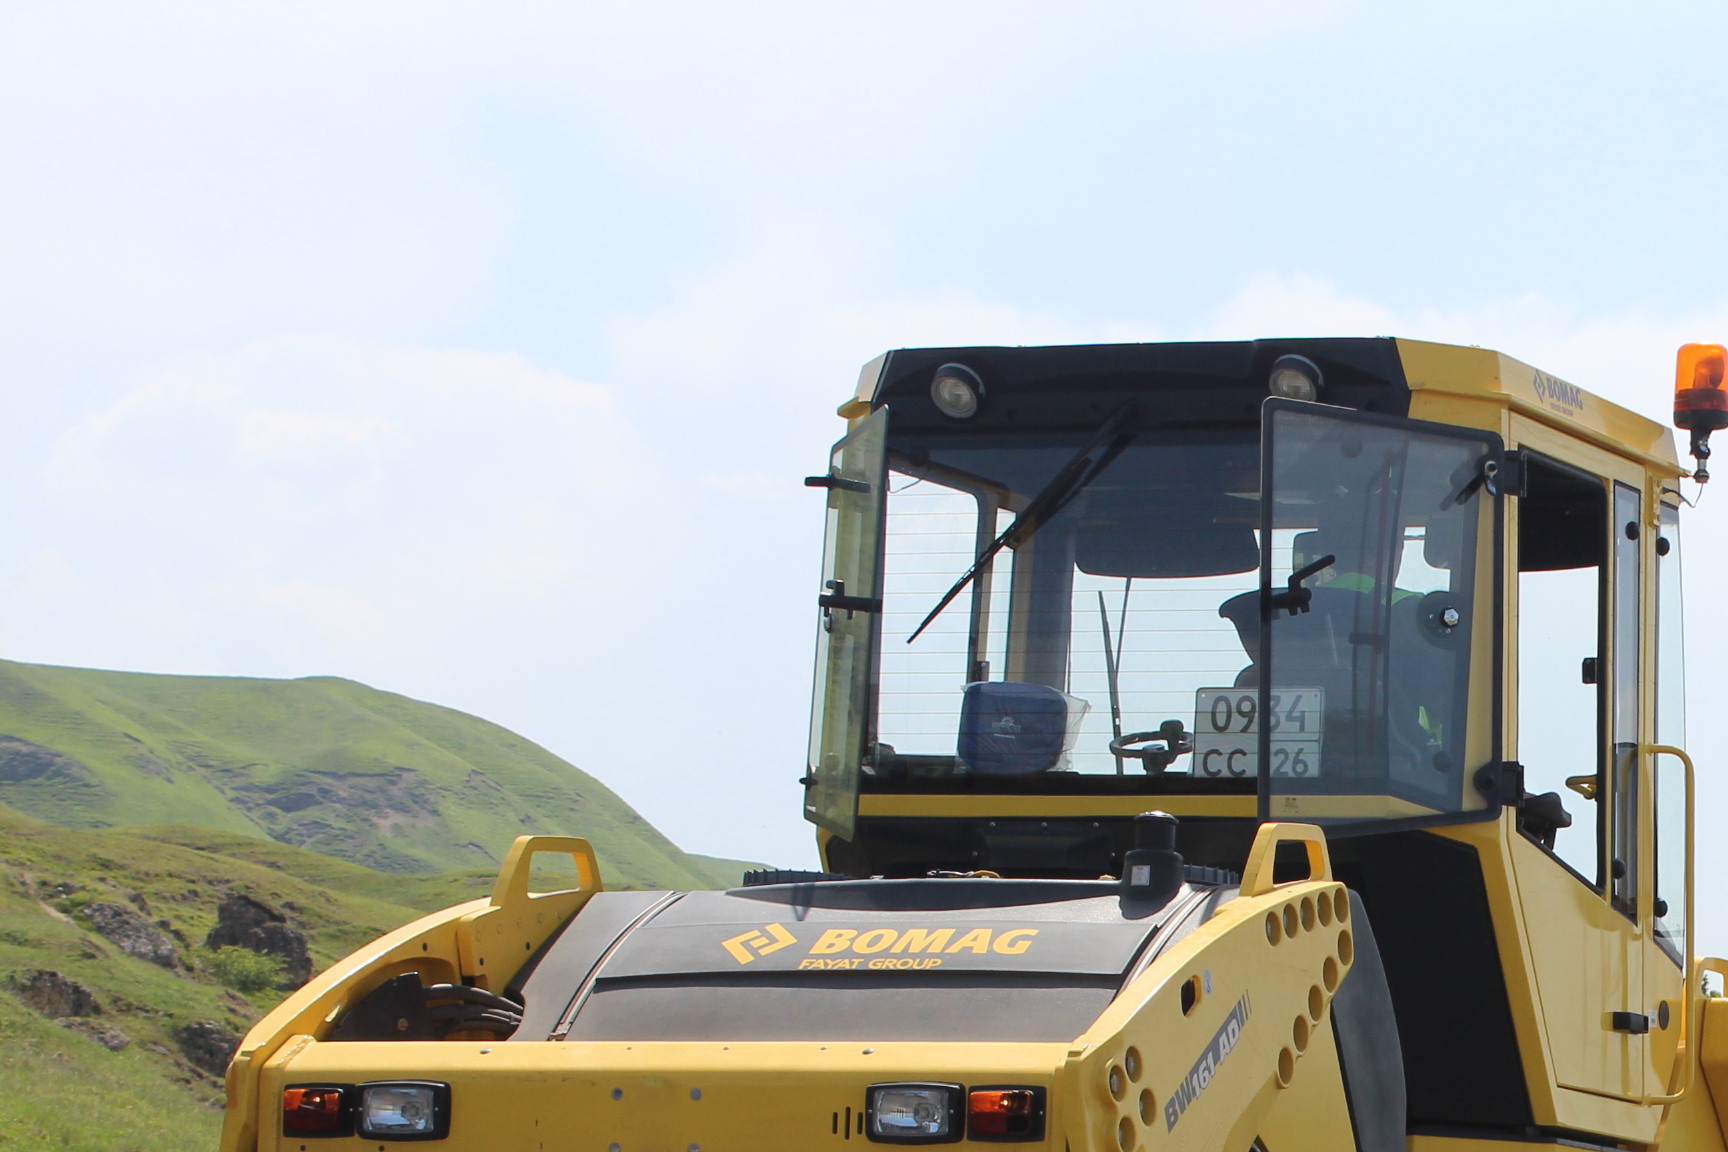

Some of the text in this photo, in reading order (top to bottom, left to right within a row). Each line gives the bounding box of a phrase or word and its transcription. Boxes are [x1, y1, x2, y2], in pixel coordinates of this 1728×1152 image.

[1546, 377, 1584, 411] BOMAG
[1202, 747, 1309, 777] CC 26
[808, 928, 1040, 955] BOMAG
[798, 958, 943, 970] FAYAT GROUP
[1218, 1018, 1240, 1066] AD
